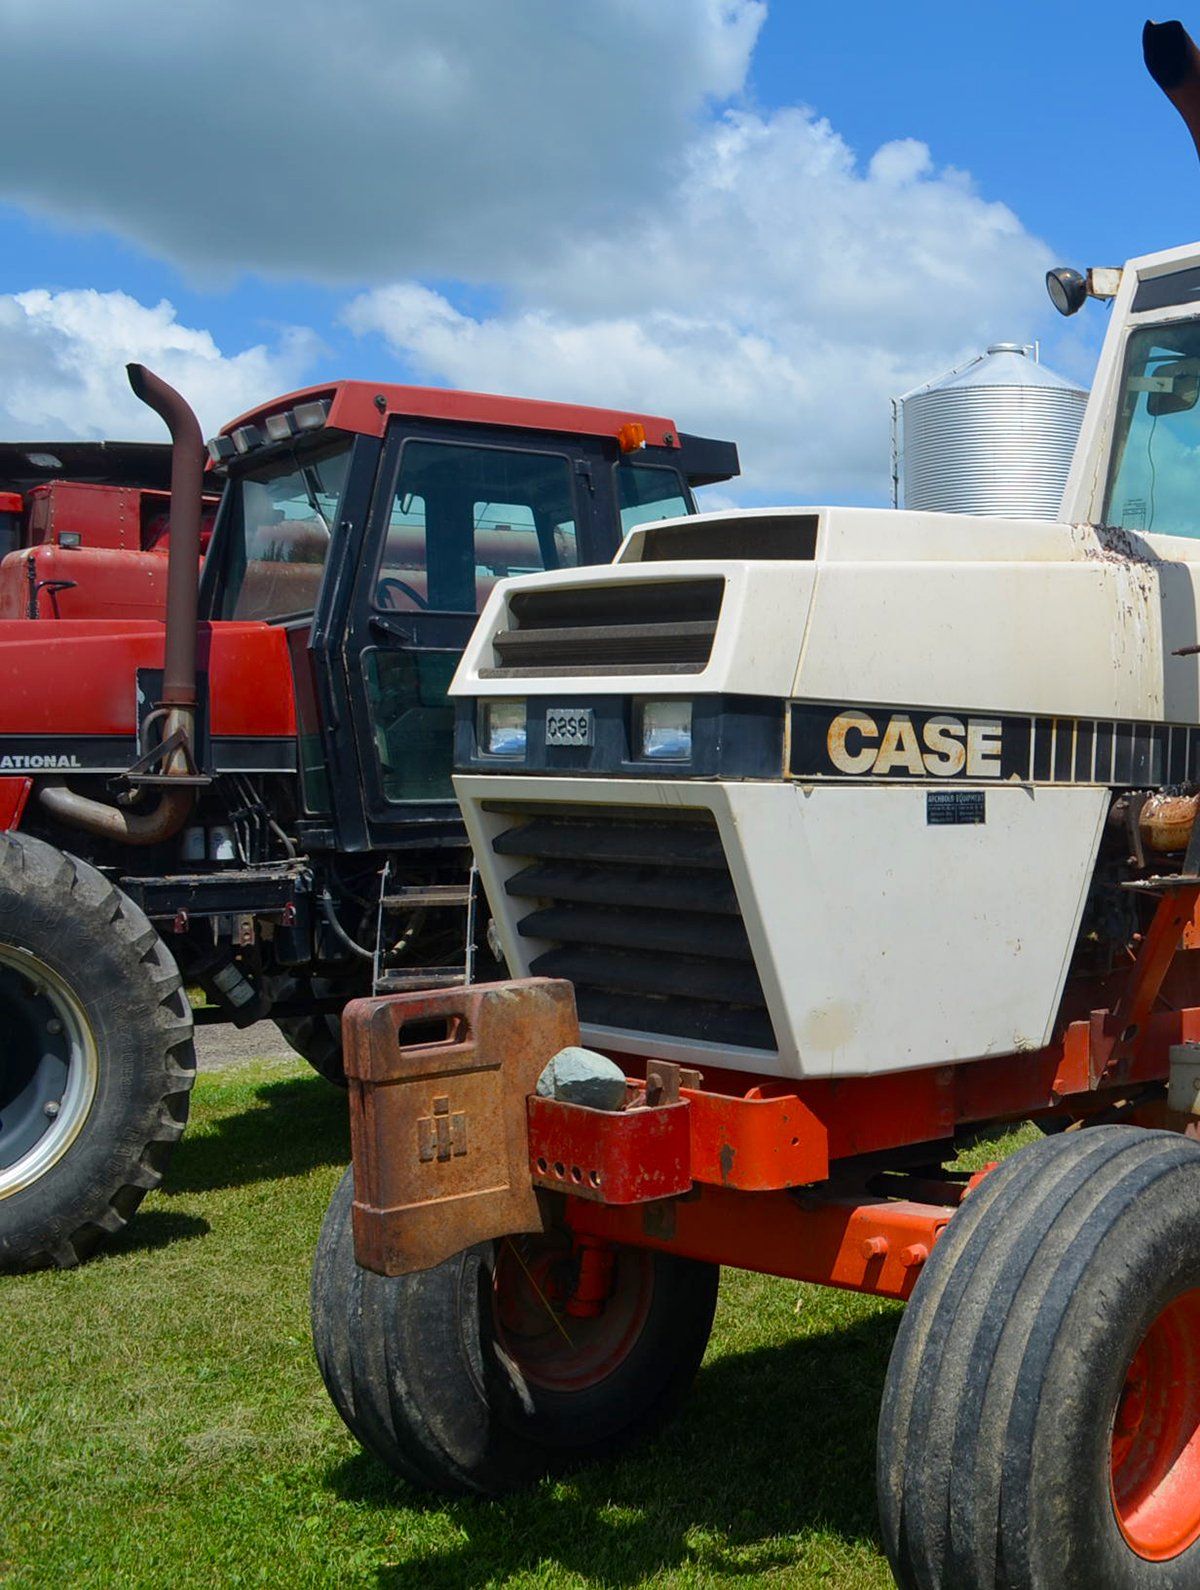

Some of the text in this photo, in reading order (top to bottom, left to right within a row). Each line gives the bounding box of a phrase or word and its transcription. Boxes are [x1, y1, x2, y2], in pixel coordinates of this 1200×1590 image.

[827, 710, 1003, 776] CASE
[0, 755, 81, 768] ATIONAL
[955, 794, 984, 804] EQUIPMENT
